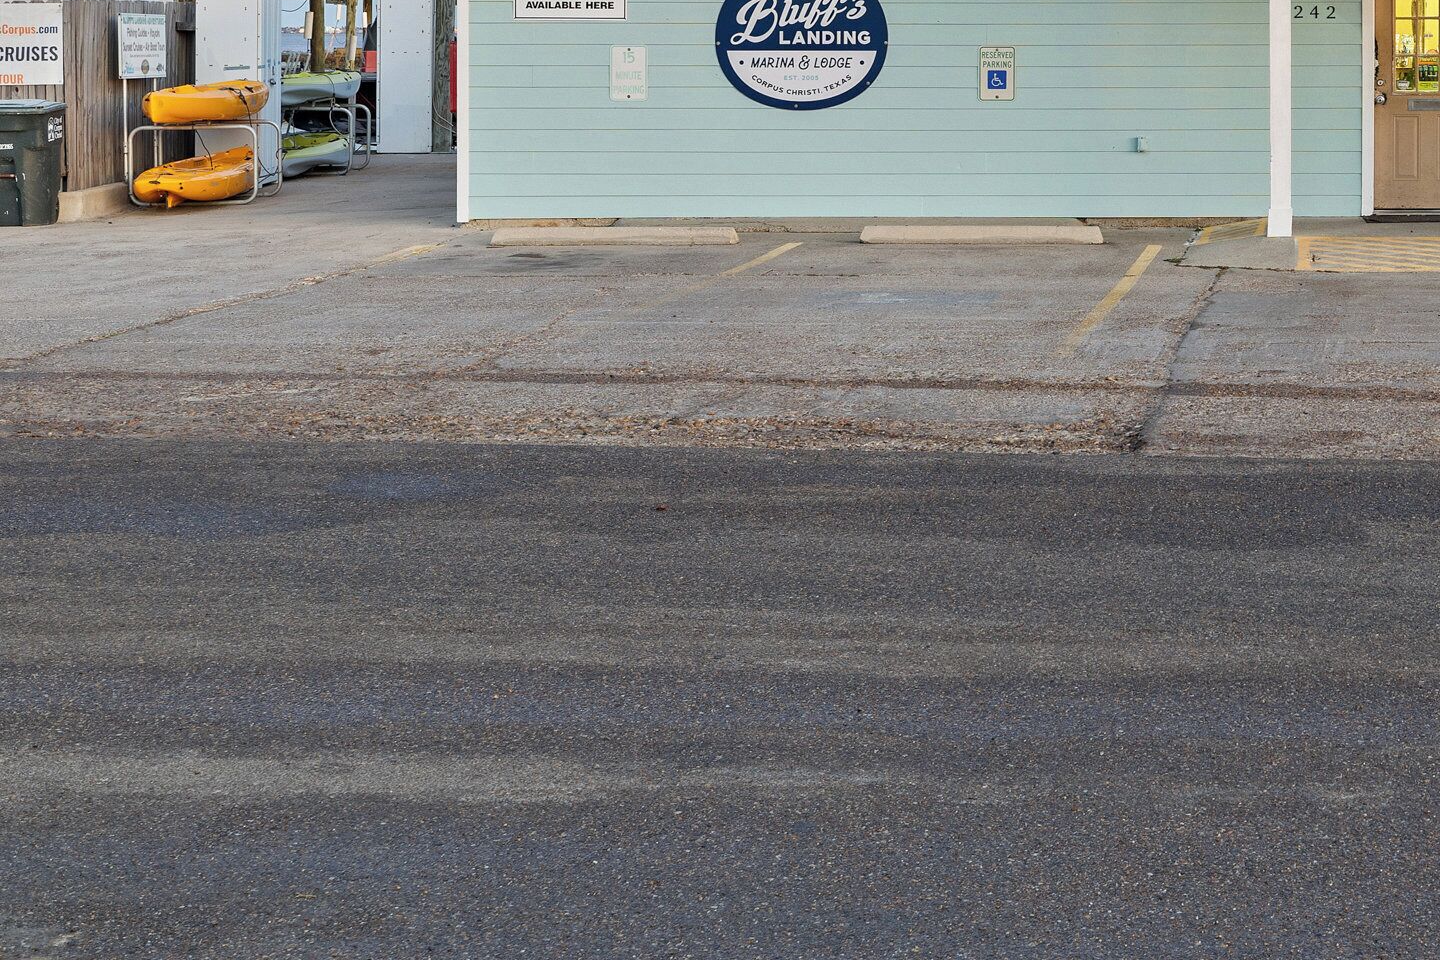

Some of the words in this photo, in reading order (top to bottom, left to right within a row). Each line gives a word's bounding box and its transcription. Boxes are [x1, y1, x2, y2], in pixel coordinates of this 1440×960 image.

[525, 1, 582, 9] AVAILABLE
[585, 1, 615, 9] HERE
[1293, 5, 1336, 19] 242
[0, 24, 58, 36] Corpus.com
[779, 31, 871, 45] LANDING
[623, 52, 635, 63] 15
[982, 51, 1013, 59] RESERVED
[750, 57, 795, 68] MARINA
[798, 55, 811, 70] &
[814, 57, 853, 68] LODGE
[983, 60, 1012, 69] PARKING
[616, 71, 642, 80] MINUTE
[613, 85, 645, 94] PARKING
[751, 74, 784, 94] CORPUS
[824, 74, 852, 92] TEXAS
